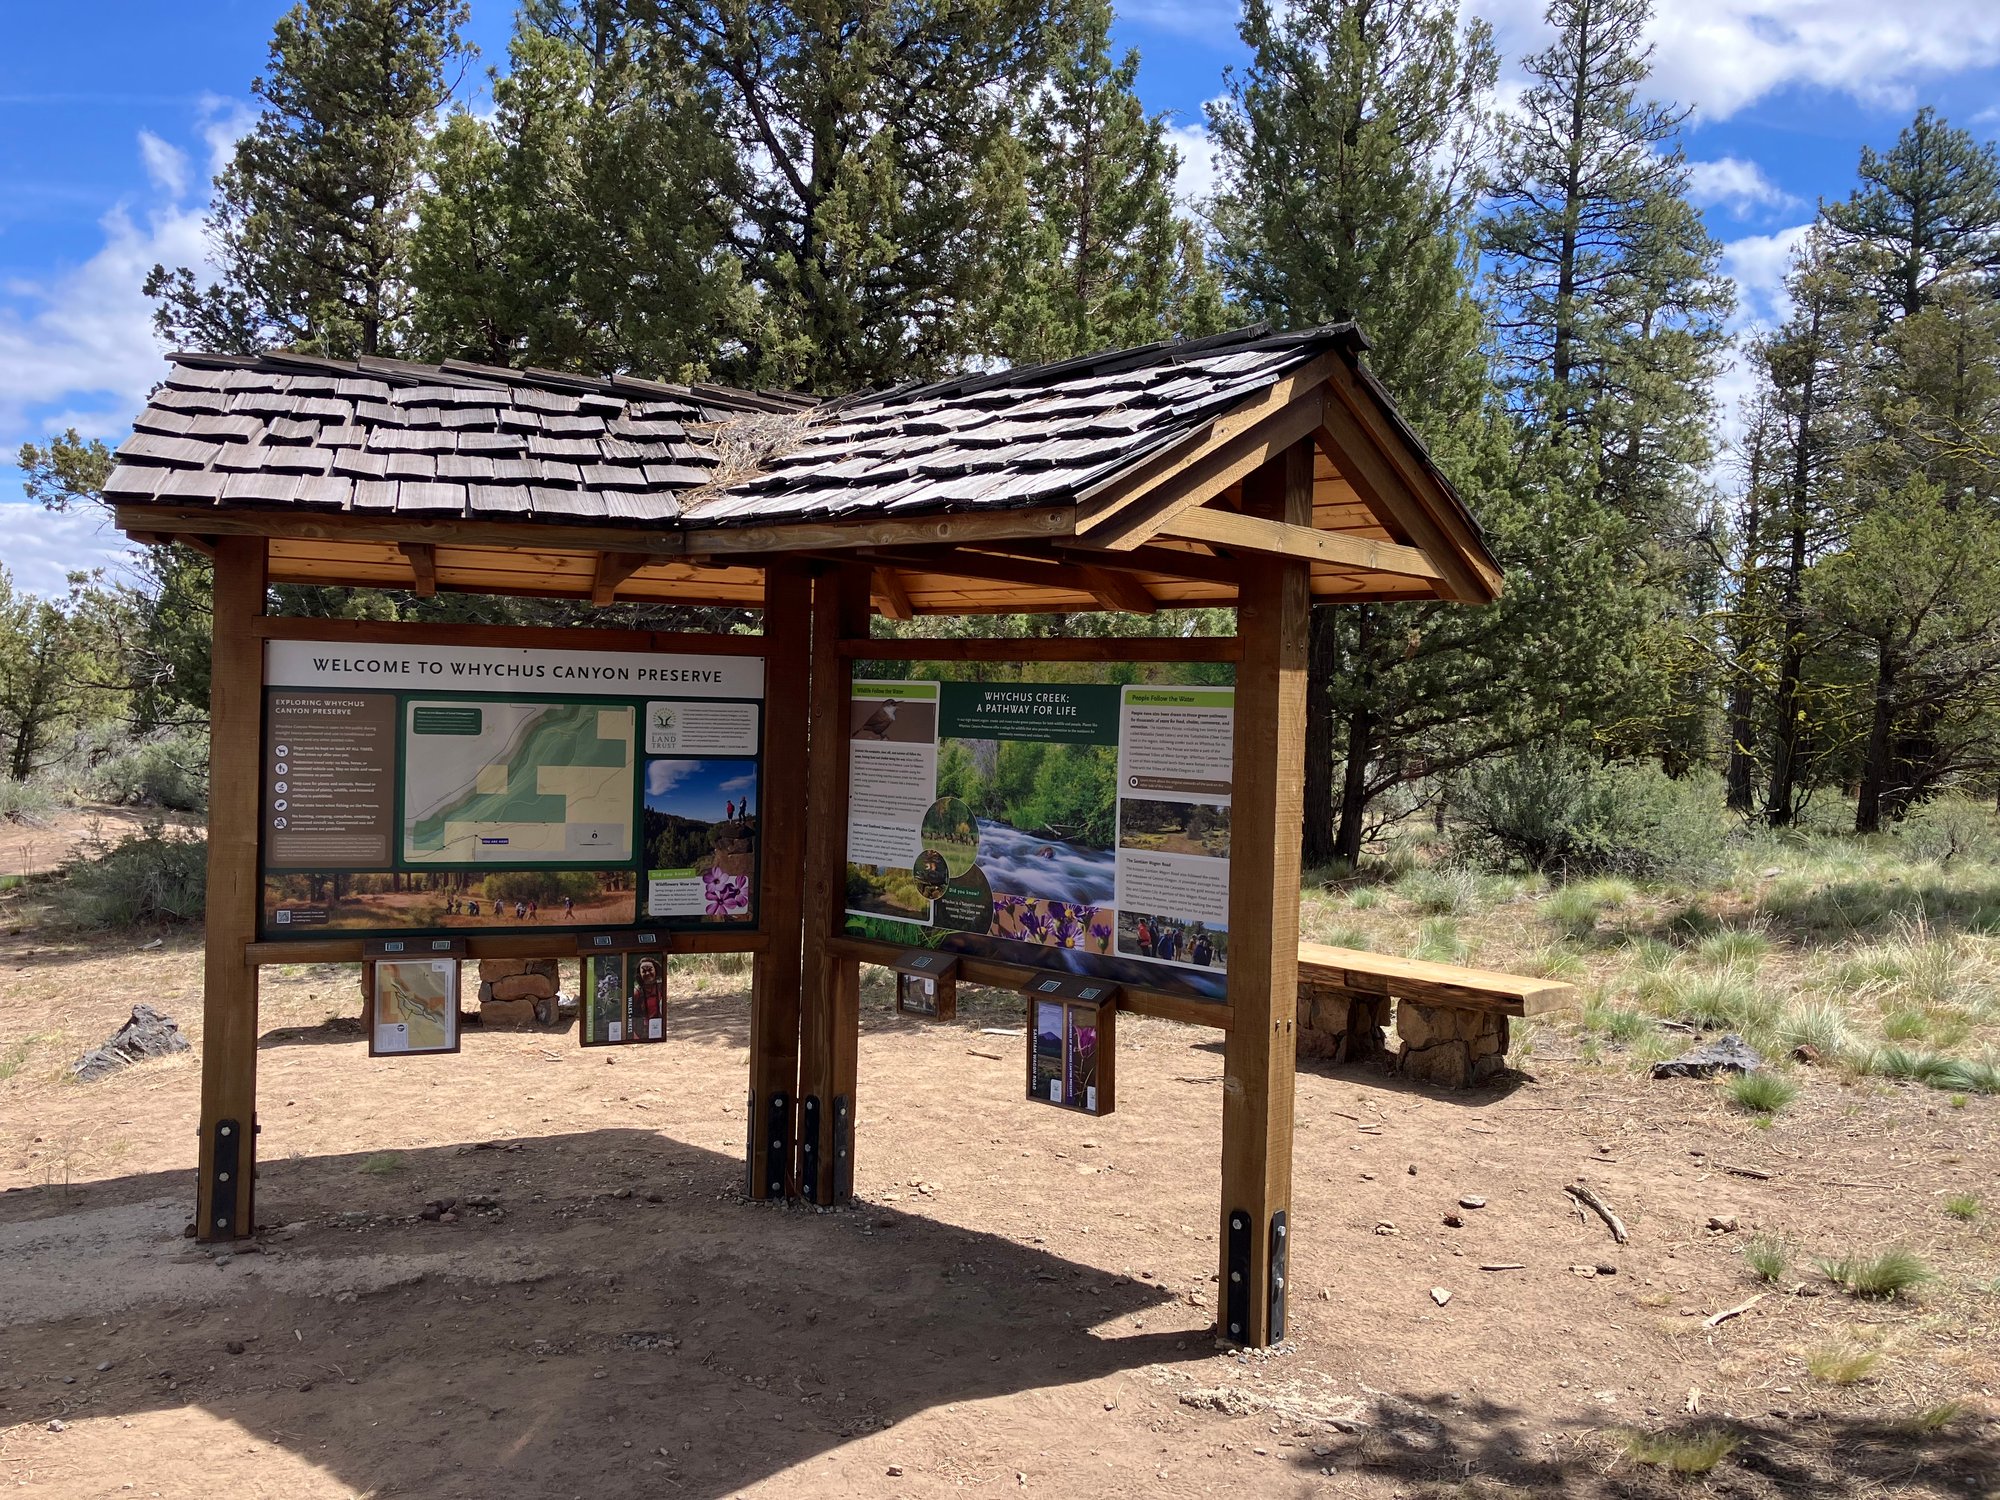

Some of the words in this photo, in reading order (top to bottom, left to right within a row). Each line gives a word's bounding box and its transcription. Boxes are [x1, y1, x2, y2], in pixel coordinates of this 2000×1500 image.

[313, 658, 411, 674] WELCOME
[418, 661, 443, 675] TO
[450, 662, 545, 677] WHYCHUS
[552, 666, 629, 680] CANYON
[638, 669, 722, 683] PRESERVE
[984, 692, 1033, 702] WHYCHUS
[1036, 693, 1070, 703] CREEK:
[976, 704, 983, 712] A
[986, 704, 1030, 714] PATHWAY
[1033, 705, 1052, 715] FOR
[1056, 706, 1077, 716] LIFE
